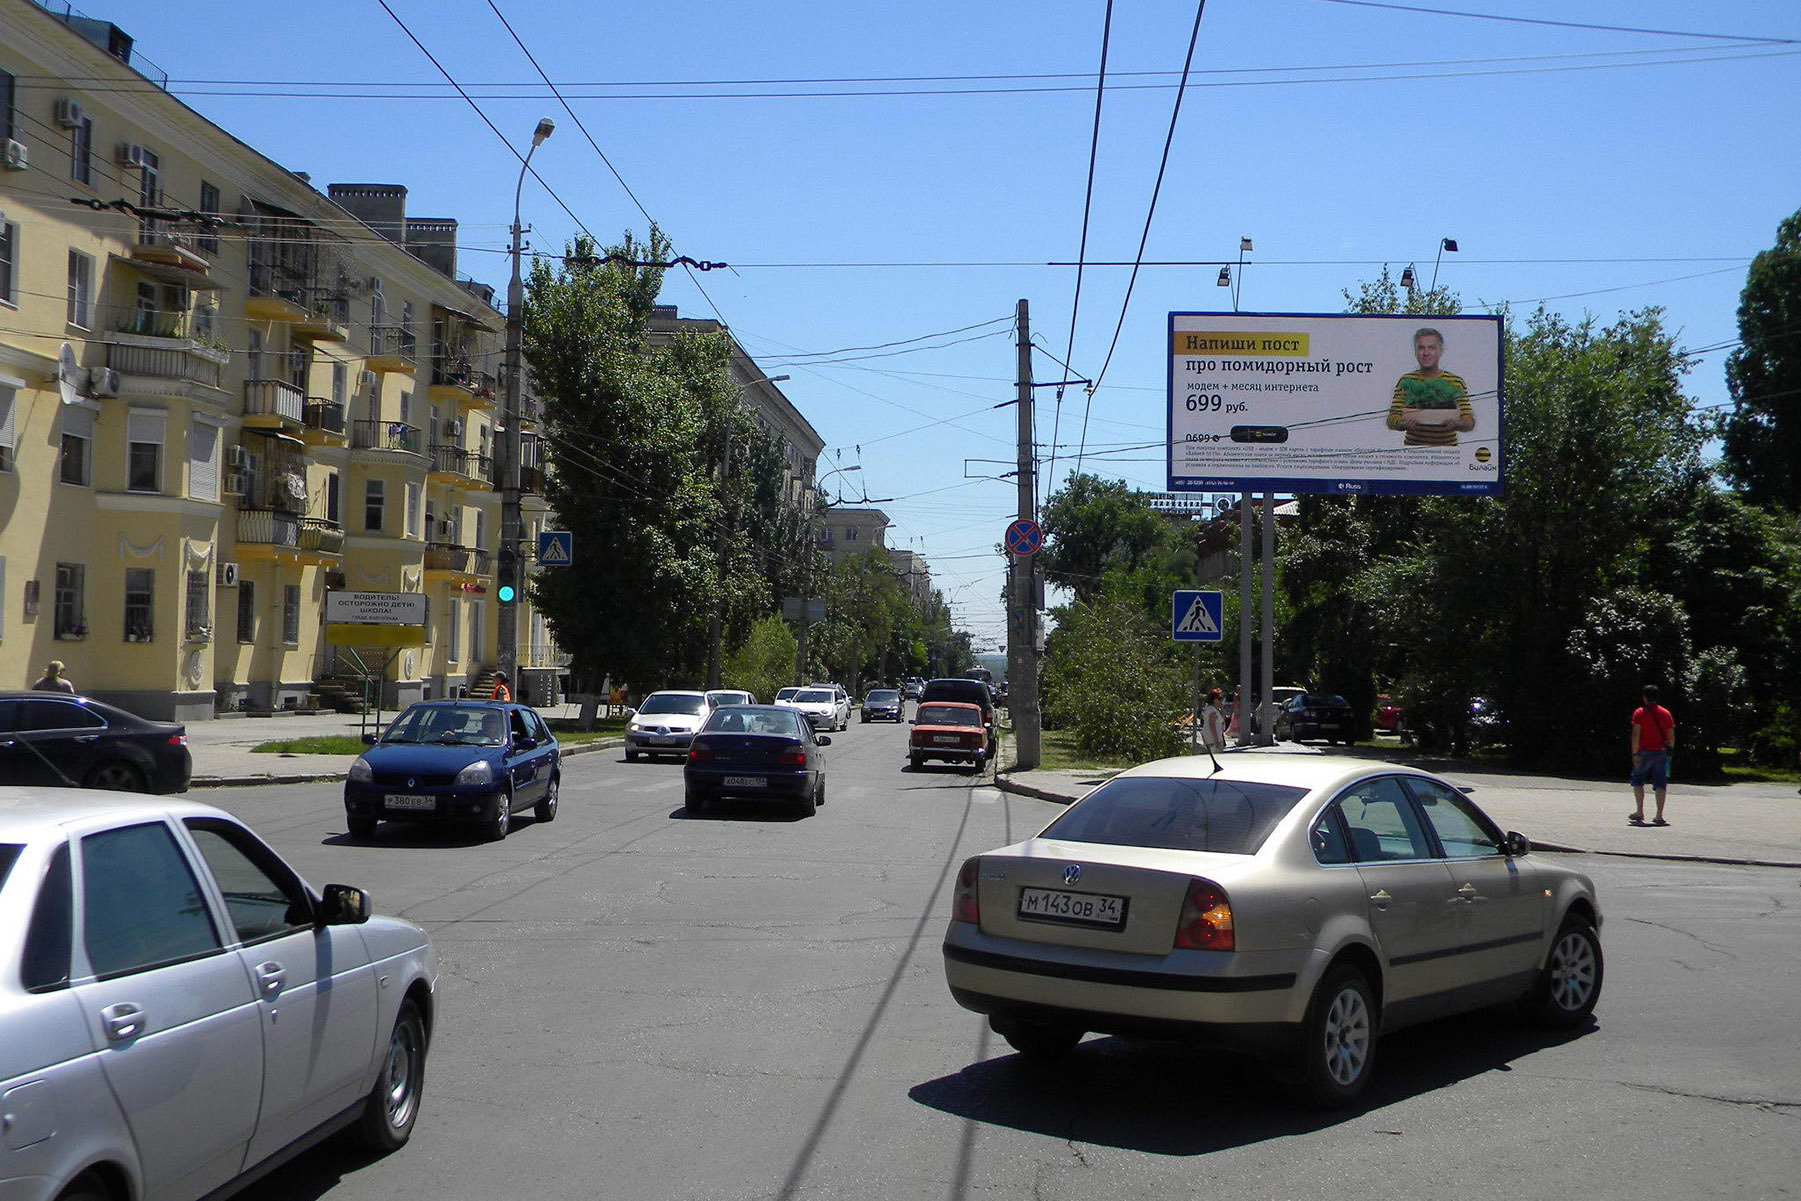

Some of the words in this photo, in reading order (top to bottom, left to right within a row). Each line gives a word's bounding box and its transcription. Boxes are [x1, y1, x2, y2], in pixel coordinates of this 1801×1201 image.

[1186, 335, 1257, 351] Напиши
[1261, 339, 1300, 352] пост
[1185, 360, 1216, 375] про
[1221, 358, 1331, 376] помидорный
[1335, 361, 1374, 377] рост
[1187, 383, 1220, 393] модем
[1231, 383, 1262, 393] месяц
[1264, 383, 1319, 394] интернета
[1185, 394, 1222, 412] 699
[1225, 402, 1249, 414] руб.
[1098, 897, 1117, 913] 34
